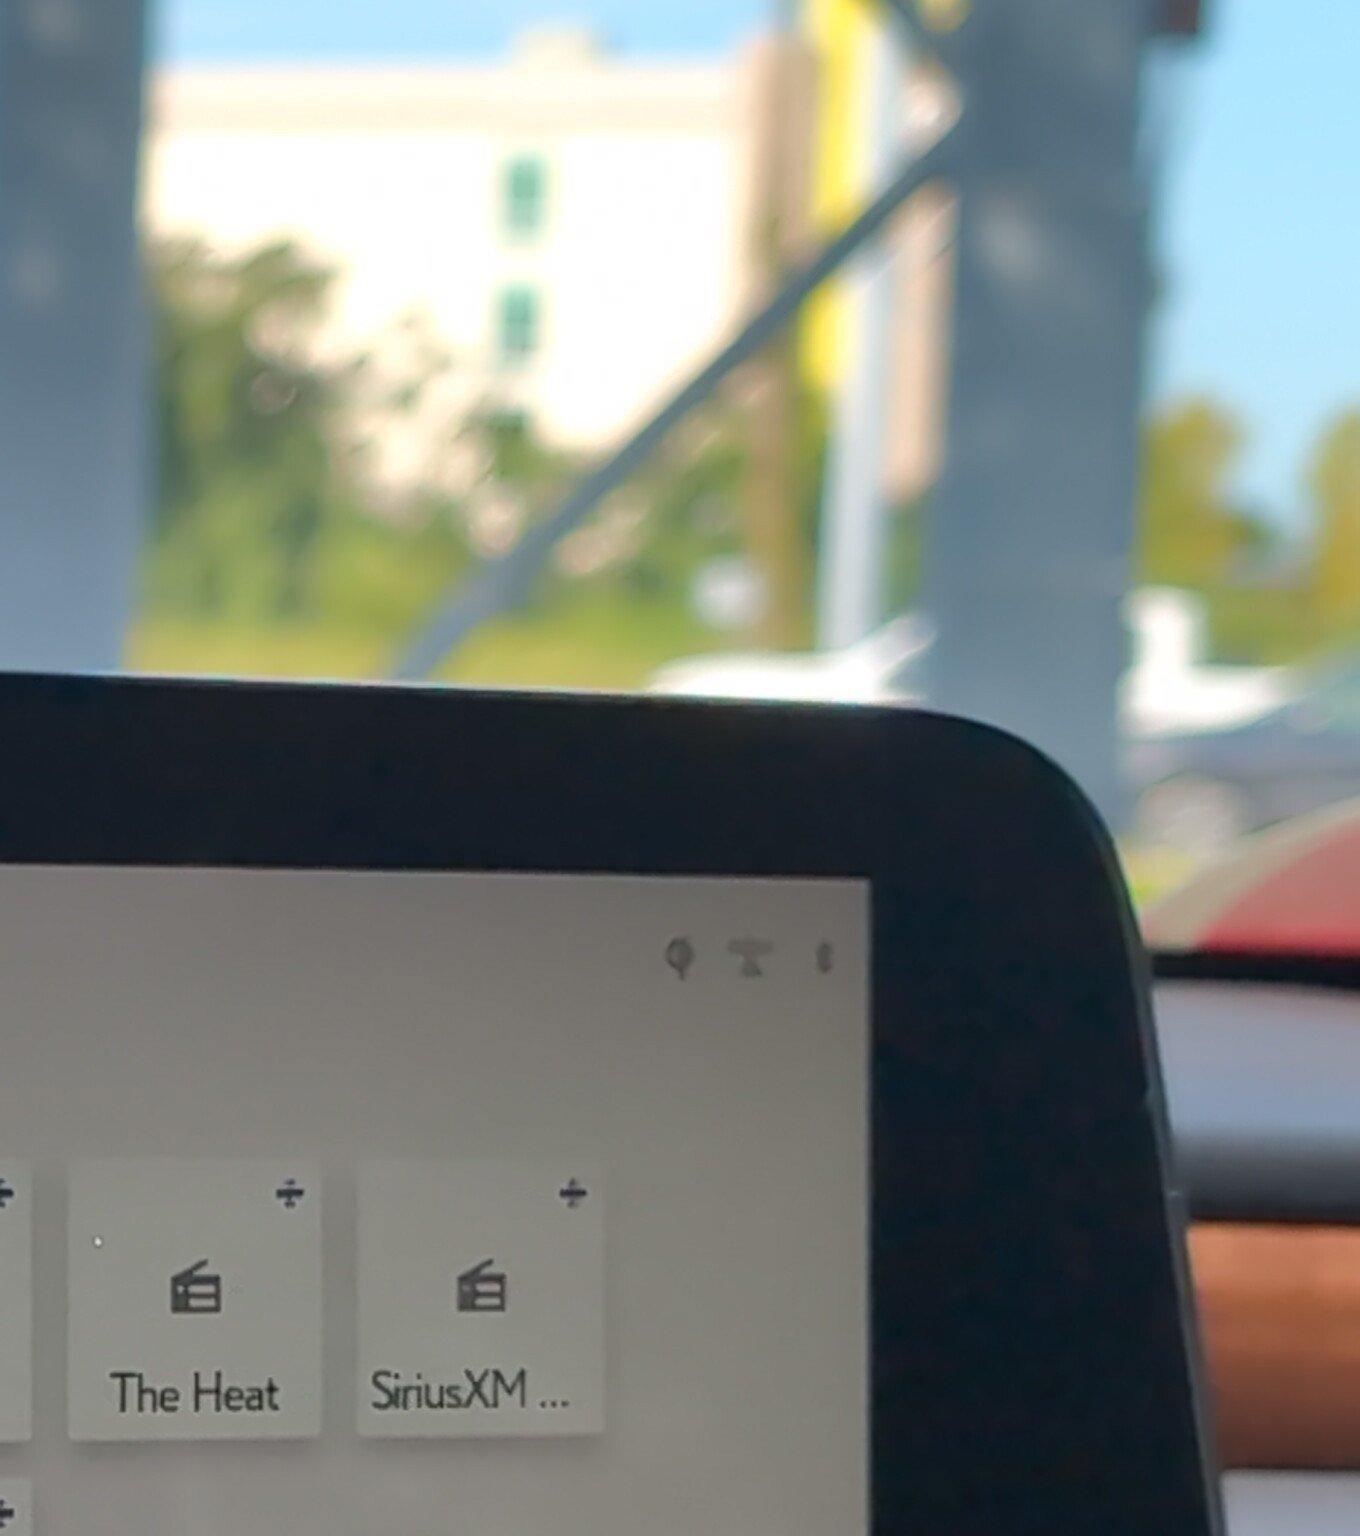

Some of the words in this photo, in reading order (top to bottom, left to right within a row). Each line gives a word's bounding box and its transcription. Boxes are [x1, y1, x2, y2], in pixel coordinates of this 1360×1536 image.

[109, 1371, 180, 1414] The
[192, 1370, 280, 1414] Heat
[371, 1367, 527, 1411] SiriusXM
